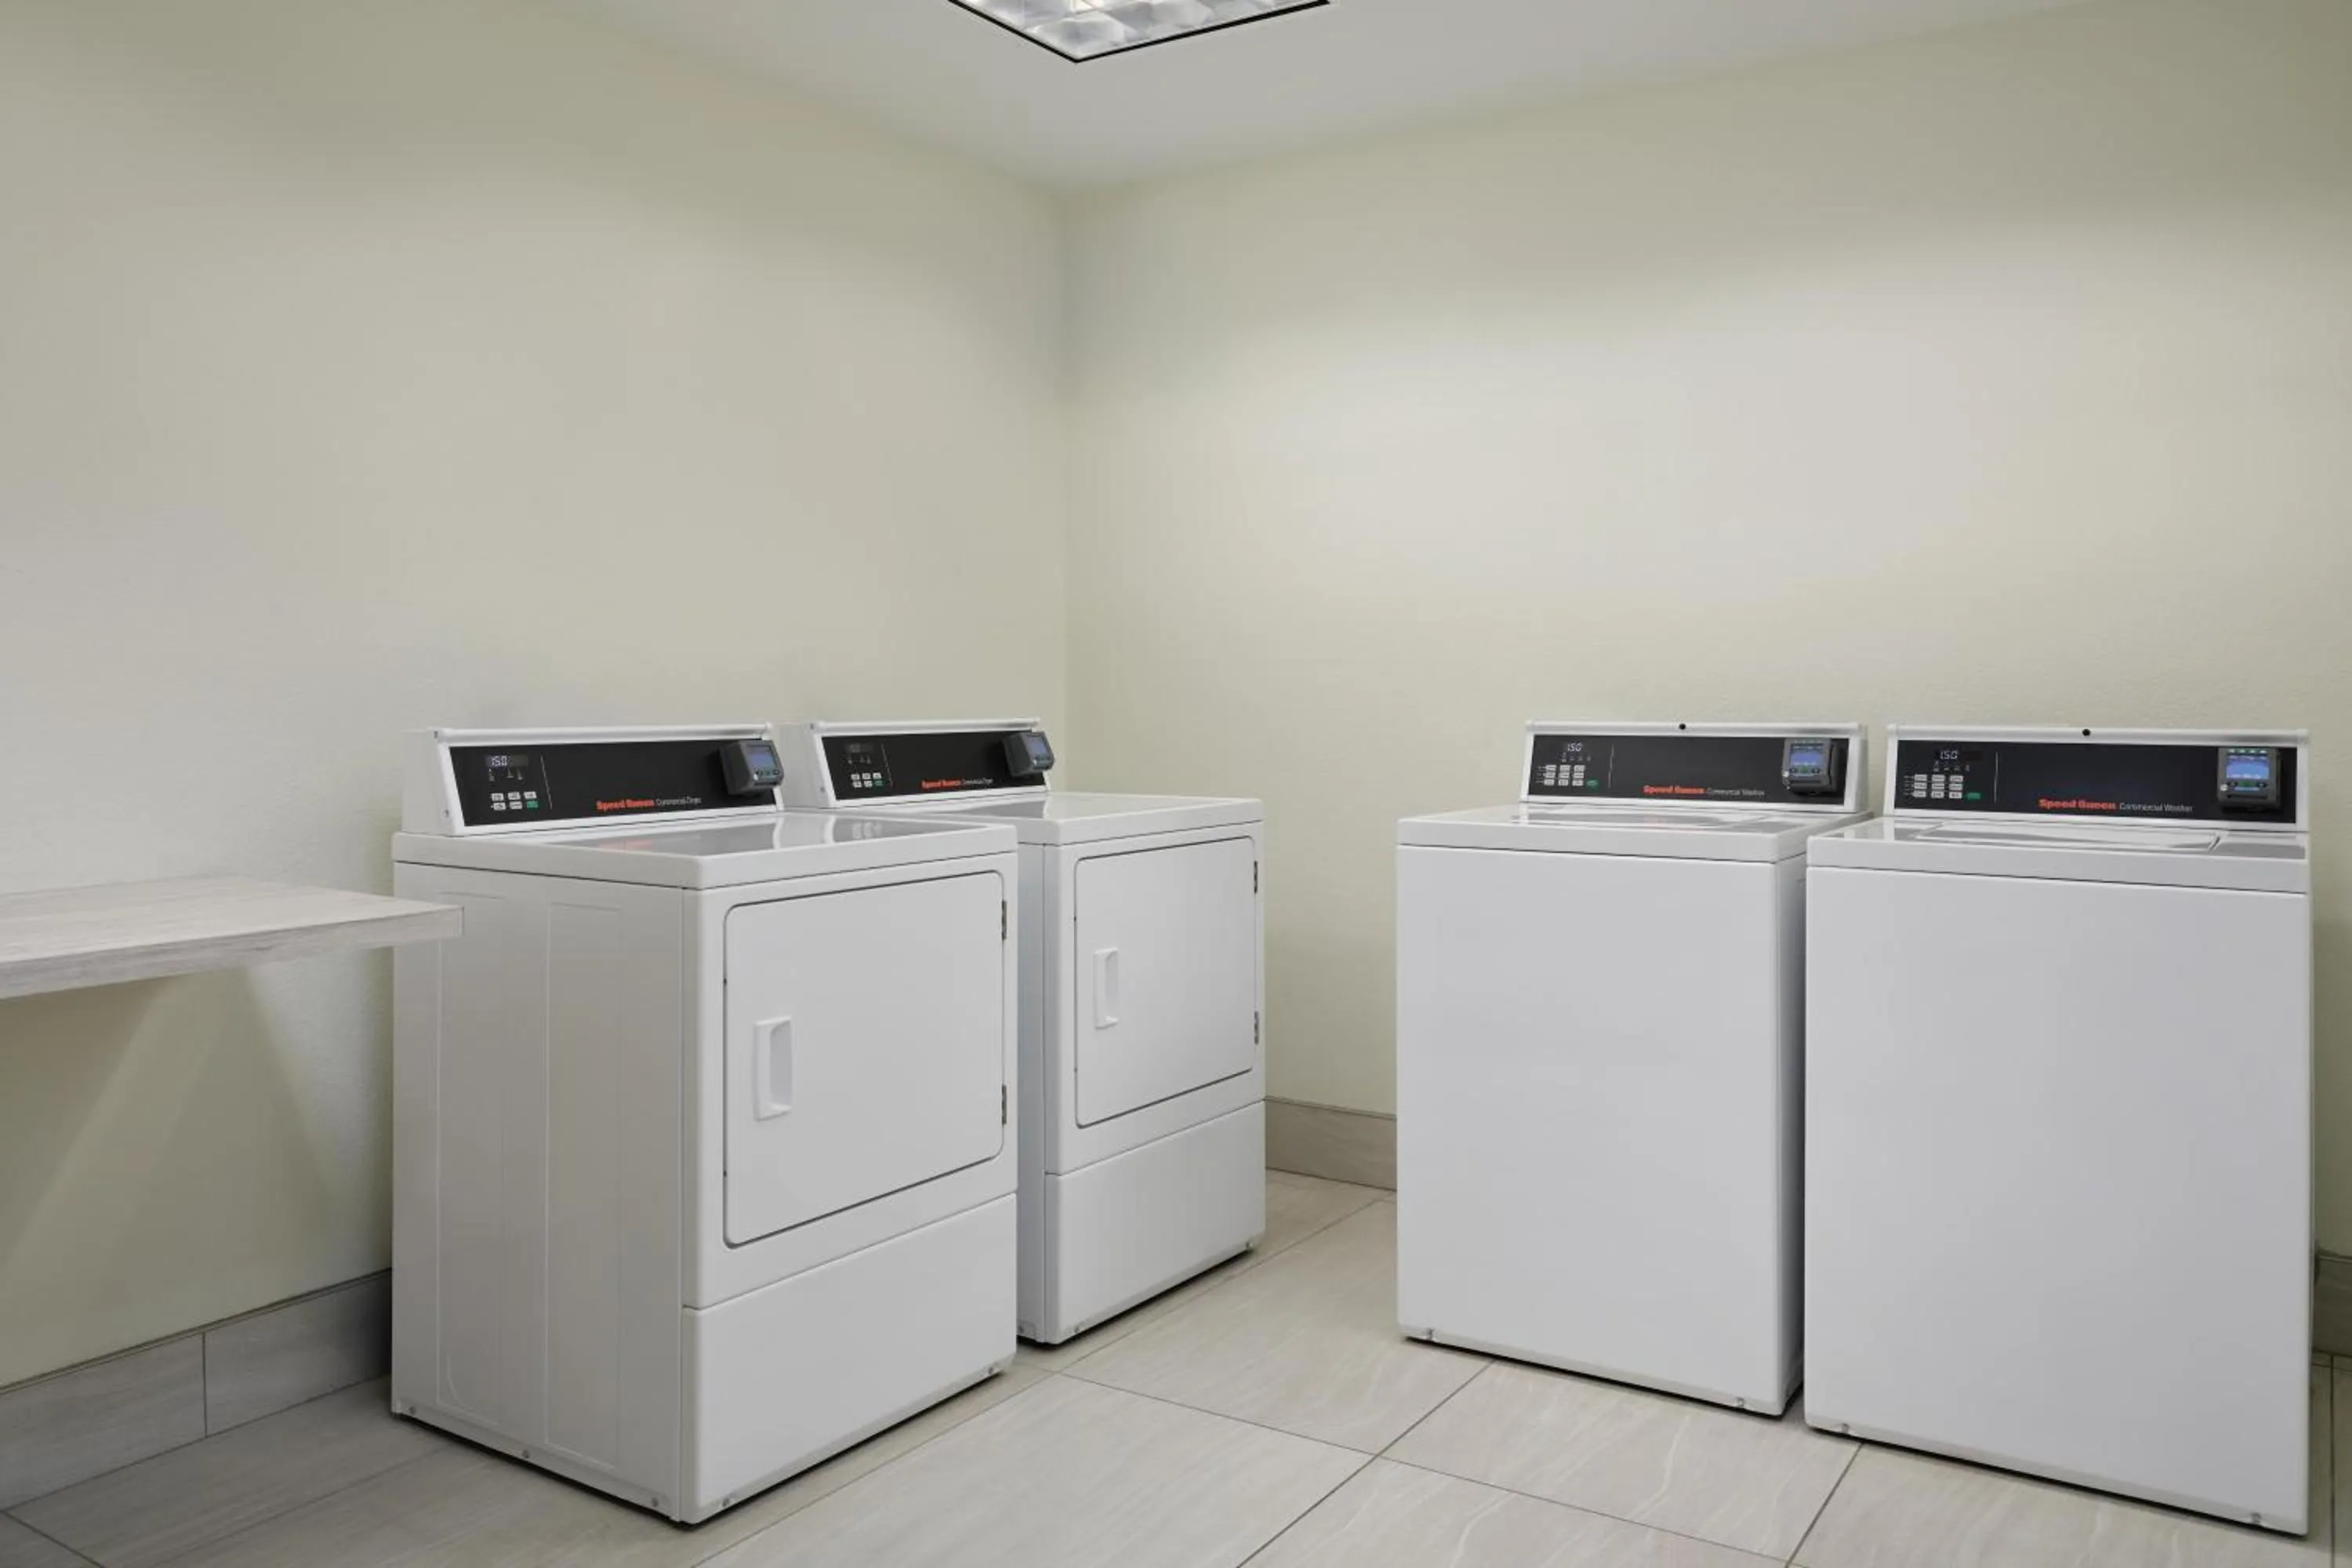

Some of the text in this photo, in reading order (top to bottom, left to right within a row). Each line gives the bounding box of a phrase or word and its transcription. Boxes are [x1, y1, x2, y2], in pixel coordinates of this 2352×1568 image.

[2038, 798, 2193, 812] Speed Queen Commercial Washer
